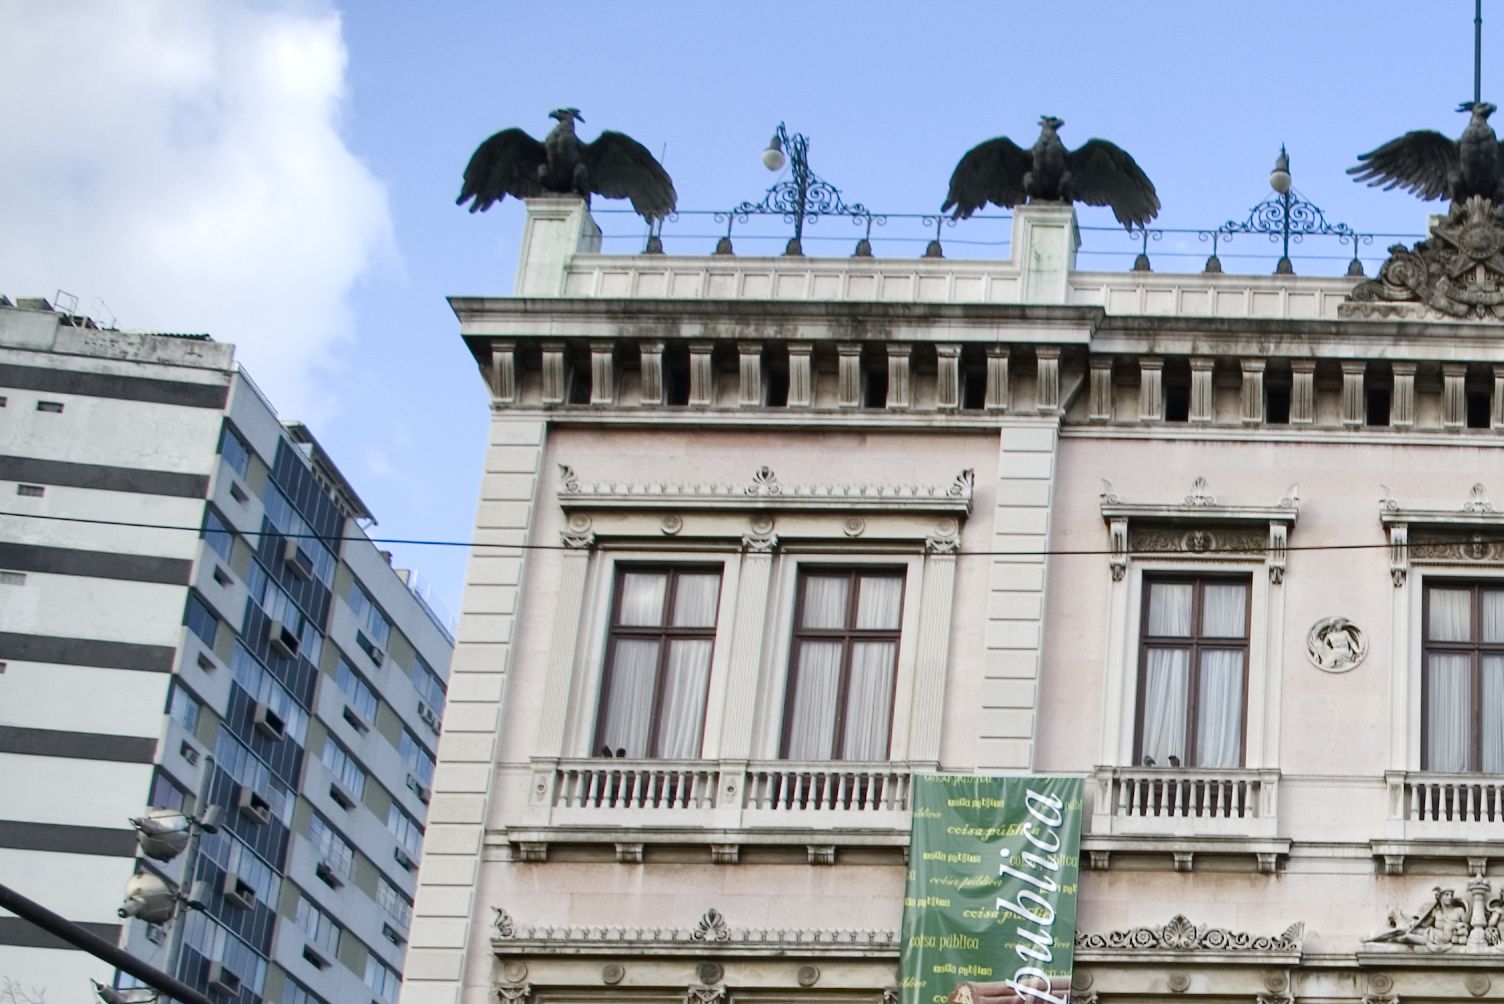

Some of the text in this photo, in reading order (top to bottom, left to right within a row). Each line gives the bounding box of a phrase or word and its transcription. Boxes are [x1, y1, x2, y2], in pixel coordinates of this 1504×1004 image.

[948, 823, 981, 836] coisa
[963, 907, 998, 919] coisa
[910, 932, 979, 951] coisa pública
